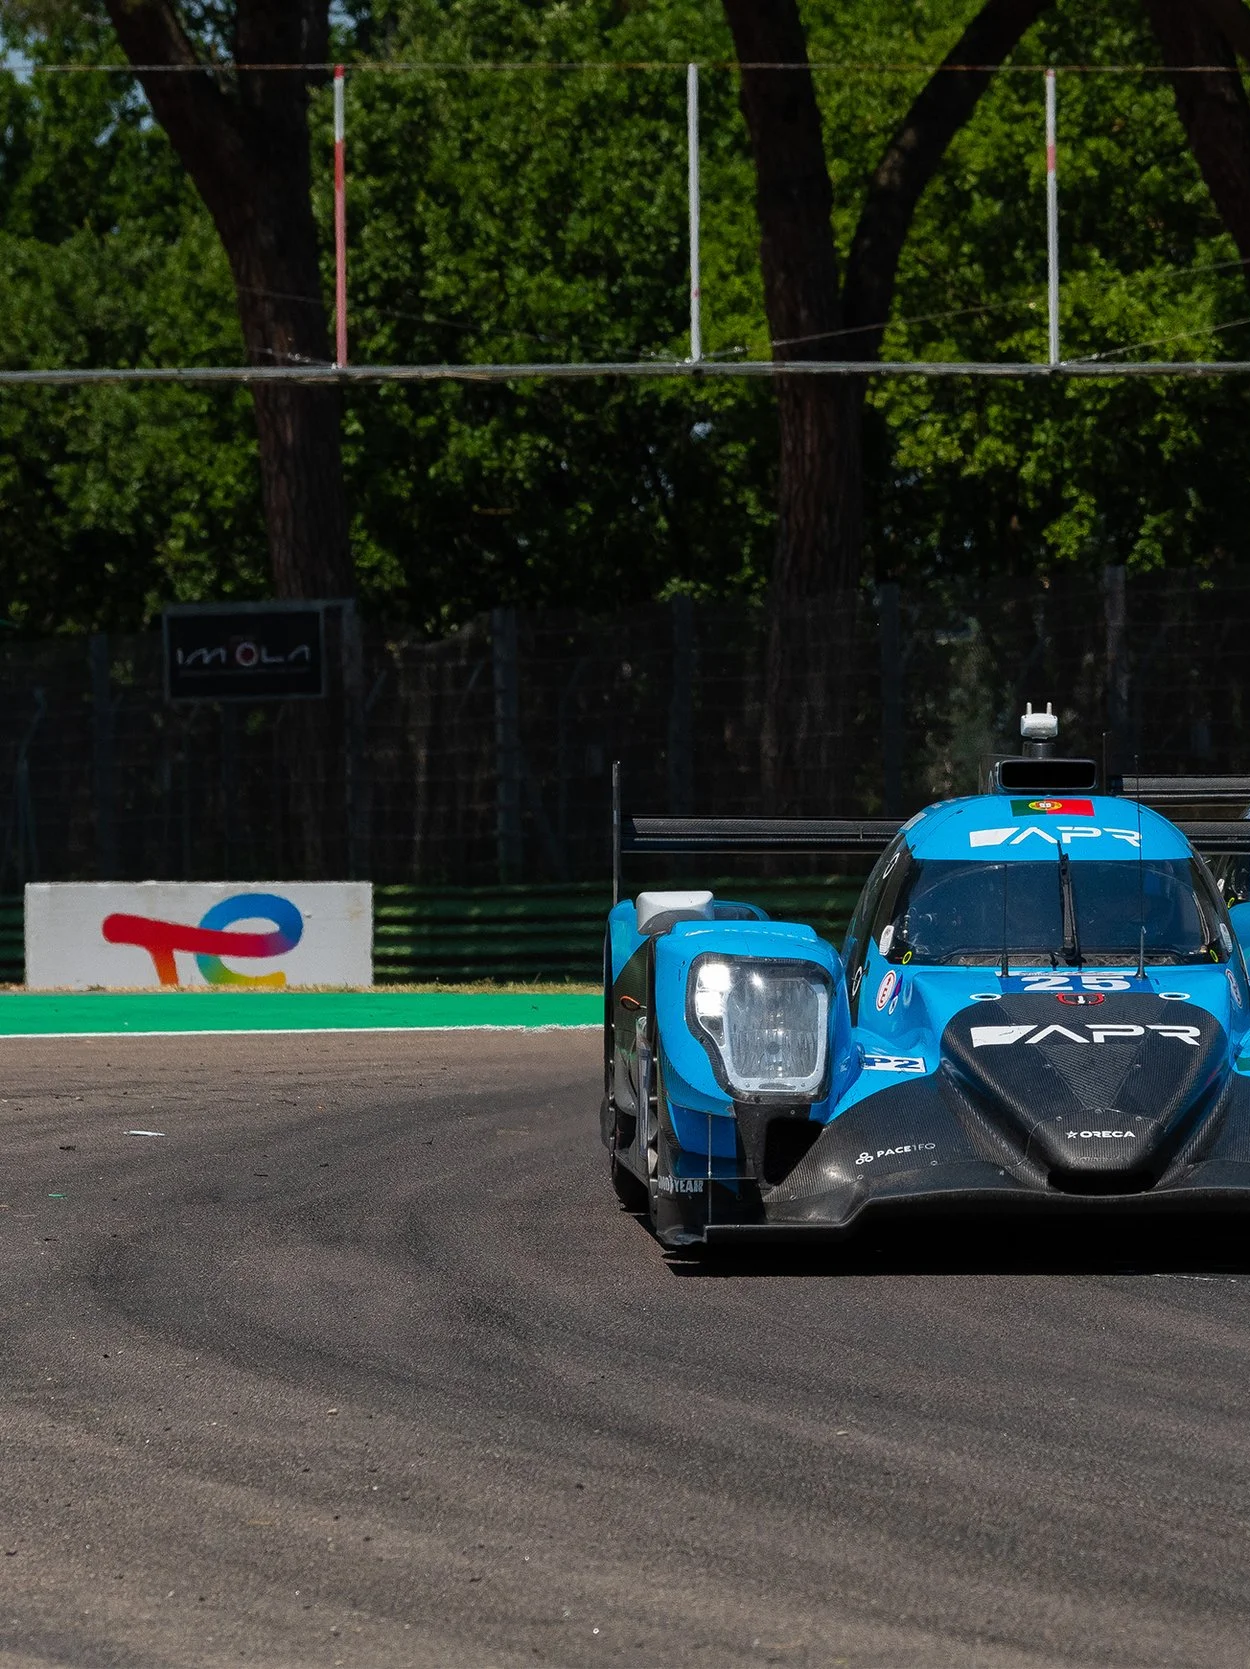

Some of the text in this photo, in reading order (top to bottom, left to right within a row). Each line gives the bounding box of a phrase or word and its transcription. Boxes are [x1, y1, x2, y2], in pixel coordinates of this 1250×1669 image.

[1009, 826, 1142, 848] APR
[1021, 975, 1132, 991] 25
[1024, 1024, 1201, 1047] APR
[1081, 1130, 1136, 1139] ORECA
